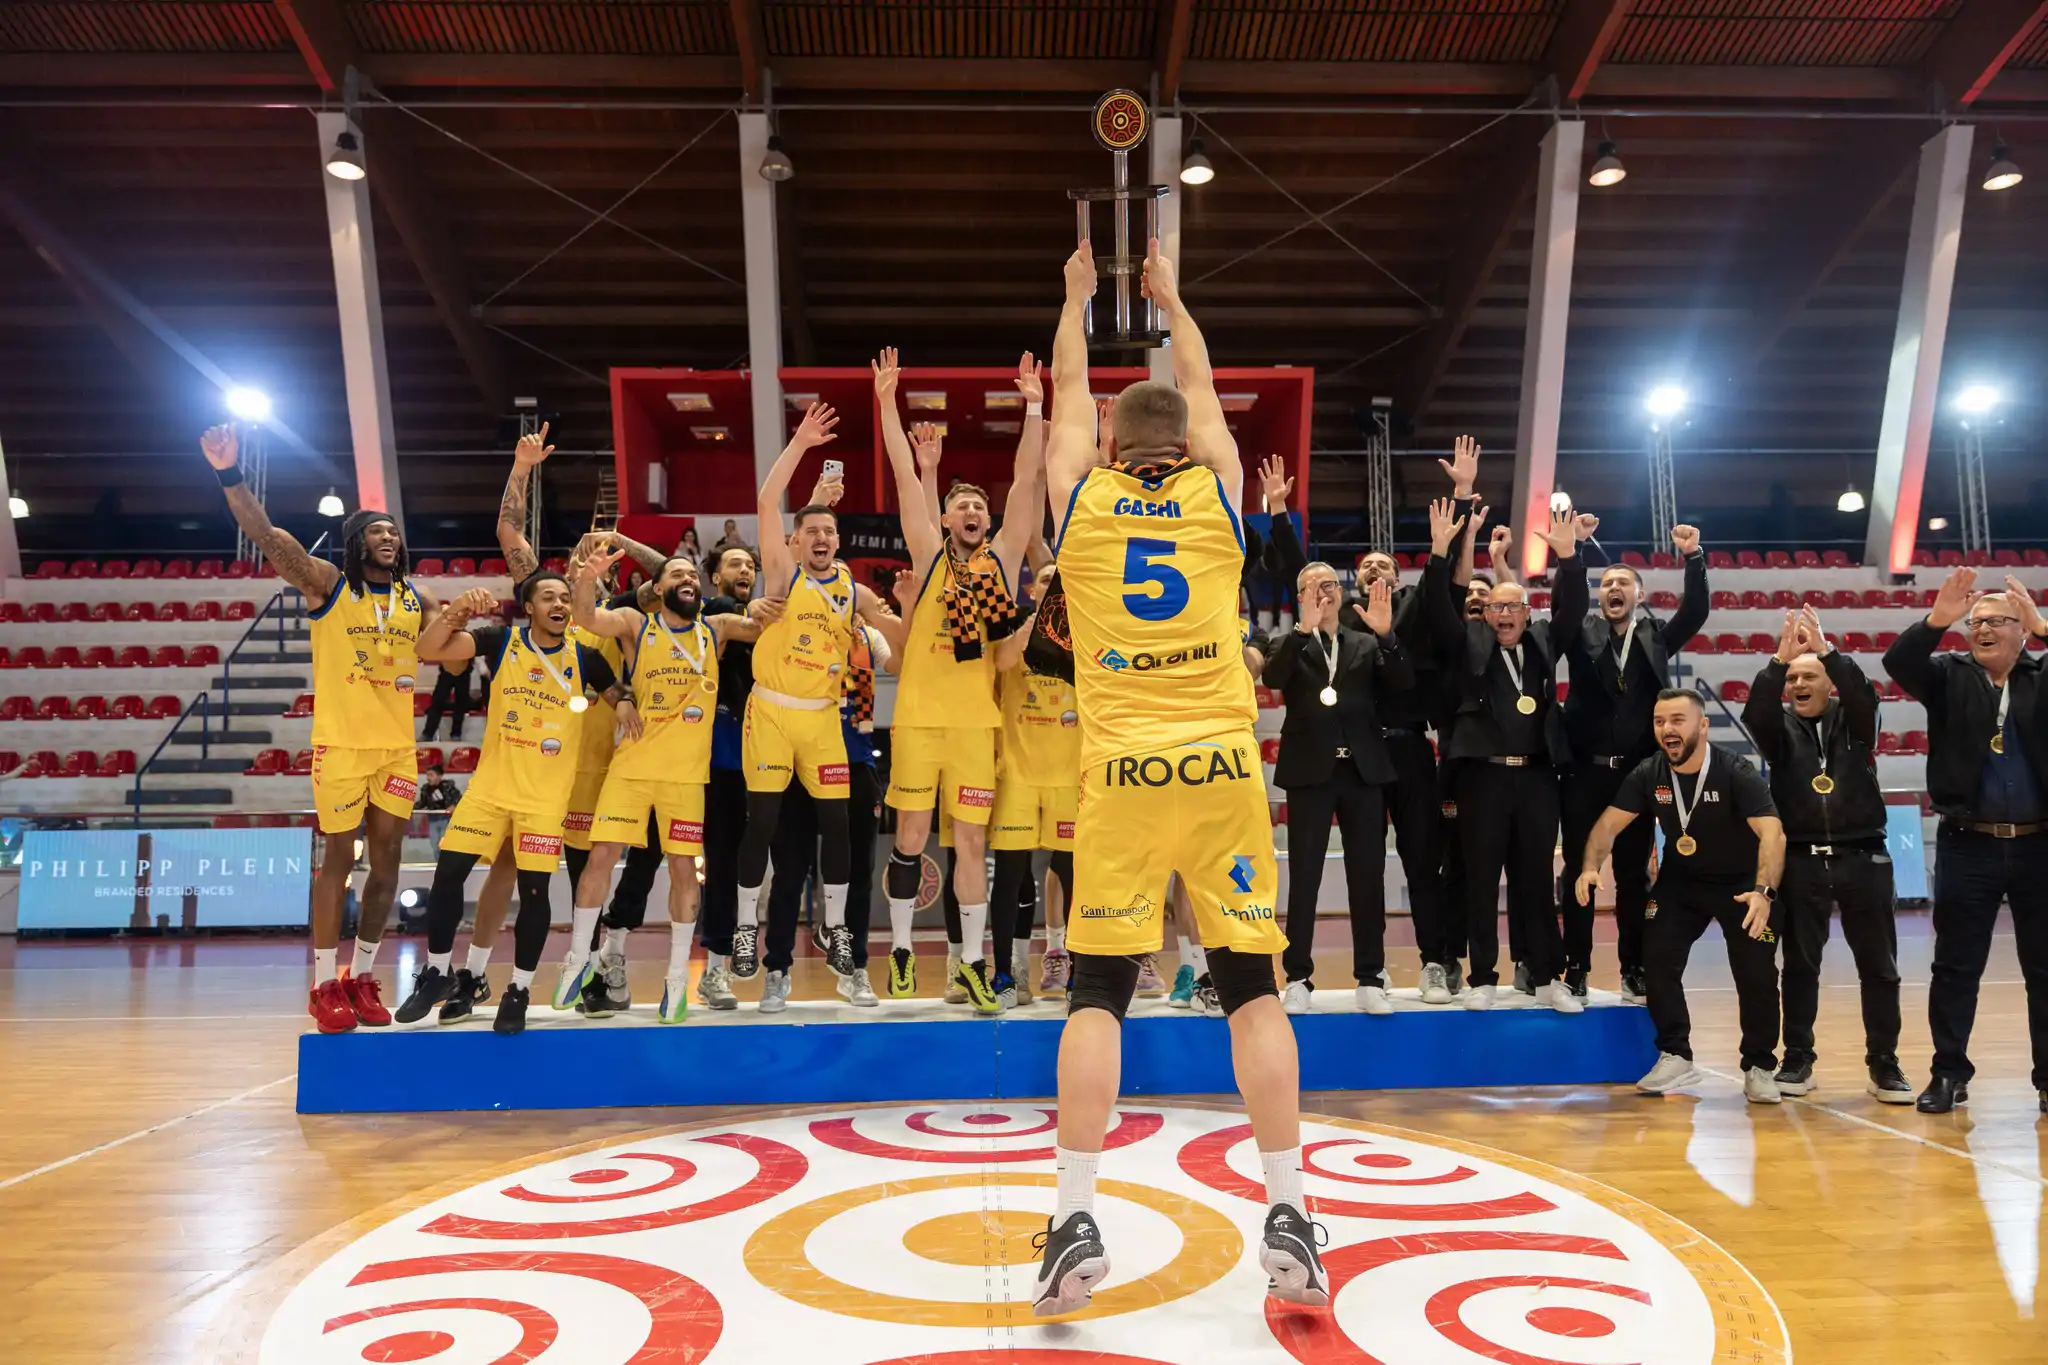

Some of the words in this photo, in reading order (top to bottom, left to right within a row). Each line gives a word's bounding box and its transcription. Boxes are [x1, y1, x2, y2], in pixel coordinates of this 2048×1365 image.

[1113, 497, 1182, 518] GASHI
[850, 534, 886, 549] JEMI
[893, 537, 909, 550] N
[1121, 537, 1190, 621] 5
[346, 626, 386, 635] GOLDE
[388, 627, 416, 643] EAGLE
[563, 666, 574, 680] 4
[645, 667, 680, 680] GOLDEN
[666, 678, 688, 686] YLLI
[538, 691, 567, 708] EAGLE
[1703, 790, 1720, 802] A.R
[453, 825, 492, 838] MERCOM
[1899, 833, 1914, 850] N
[520, 843, 557, 856] PARTNER
[30, 859, 173, 878] PHILIPP
[199, 857, 302, 876] PLEIN
[94, 886, 154, 897] BRANDED
[157, 884, 235, 897] RESIDENCES
[1080, 904, 1106, 916] Gani
[1107, 904, 1150, 916] Transport
[1757, 934, 1776, 943] A.R
